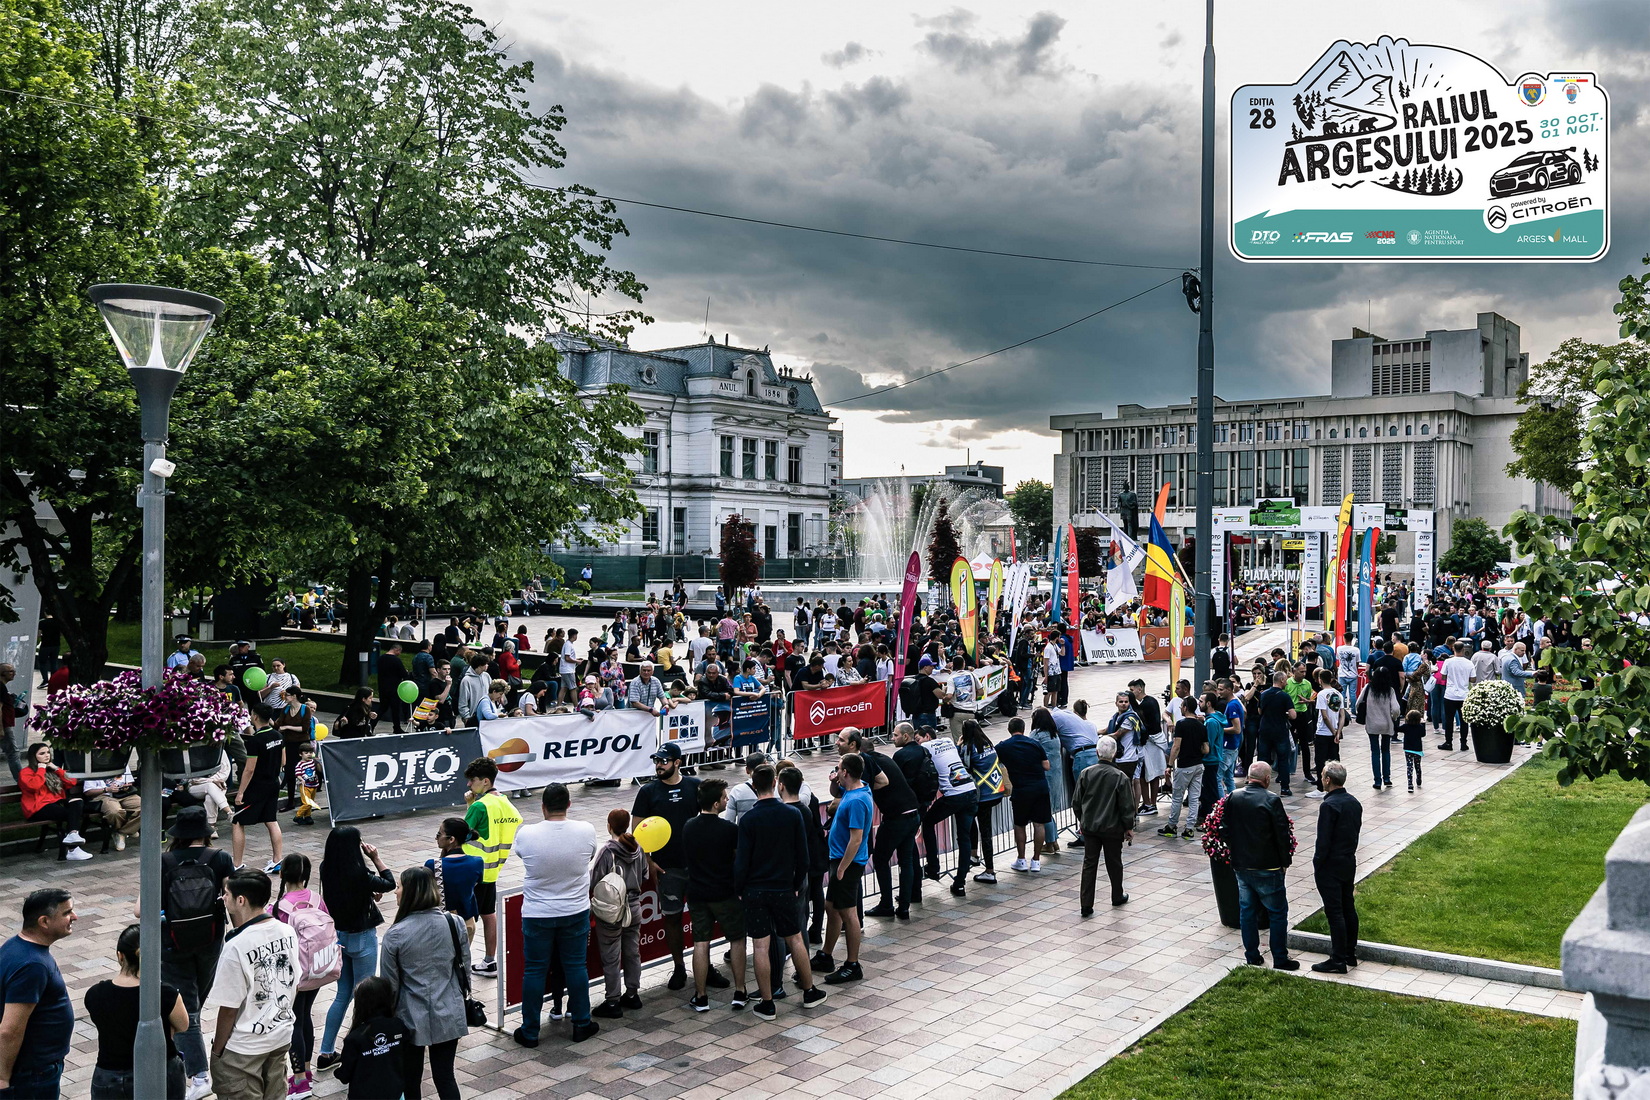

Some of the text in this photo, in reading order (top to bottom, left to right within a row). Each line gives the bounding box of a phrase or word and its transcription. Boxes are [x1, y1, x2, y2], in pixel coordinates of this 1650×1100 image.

[719, 382, 738, 392] ANUL
[543, 733, 643, 760] REPSOL
[364, 747, 461, 790] DTO
[372, 783, 443, 801] RALLY TEAM
[246, 936, 295, 965] DESERT
